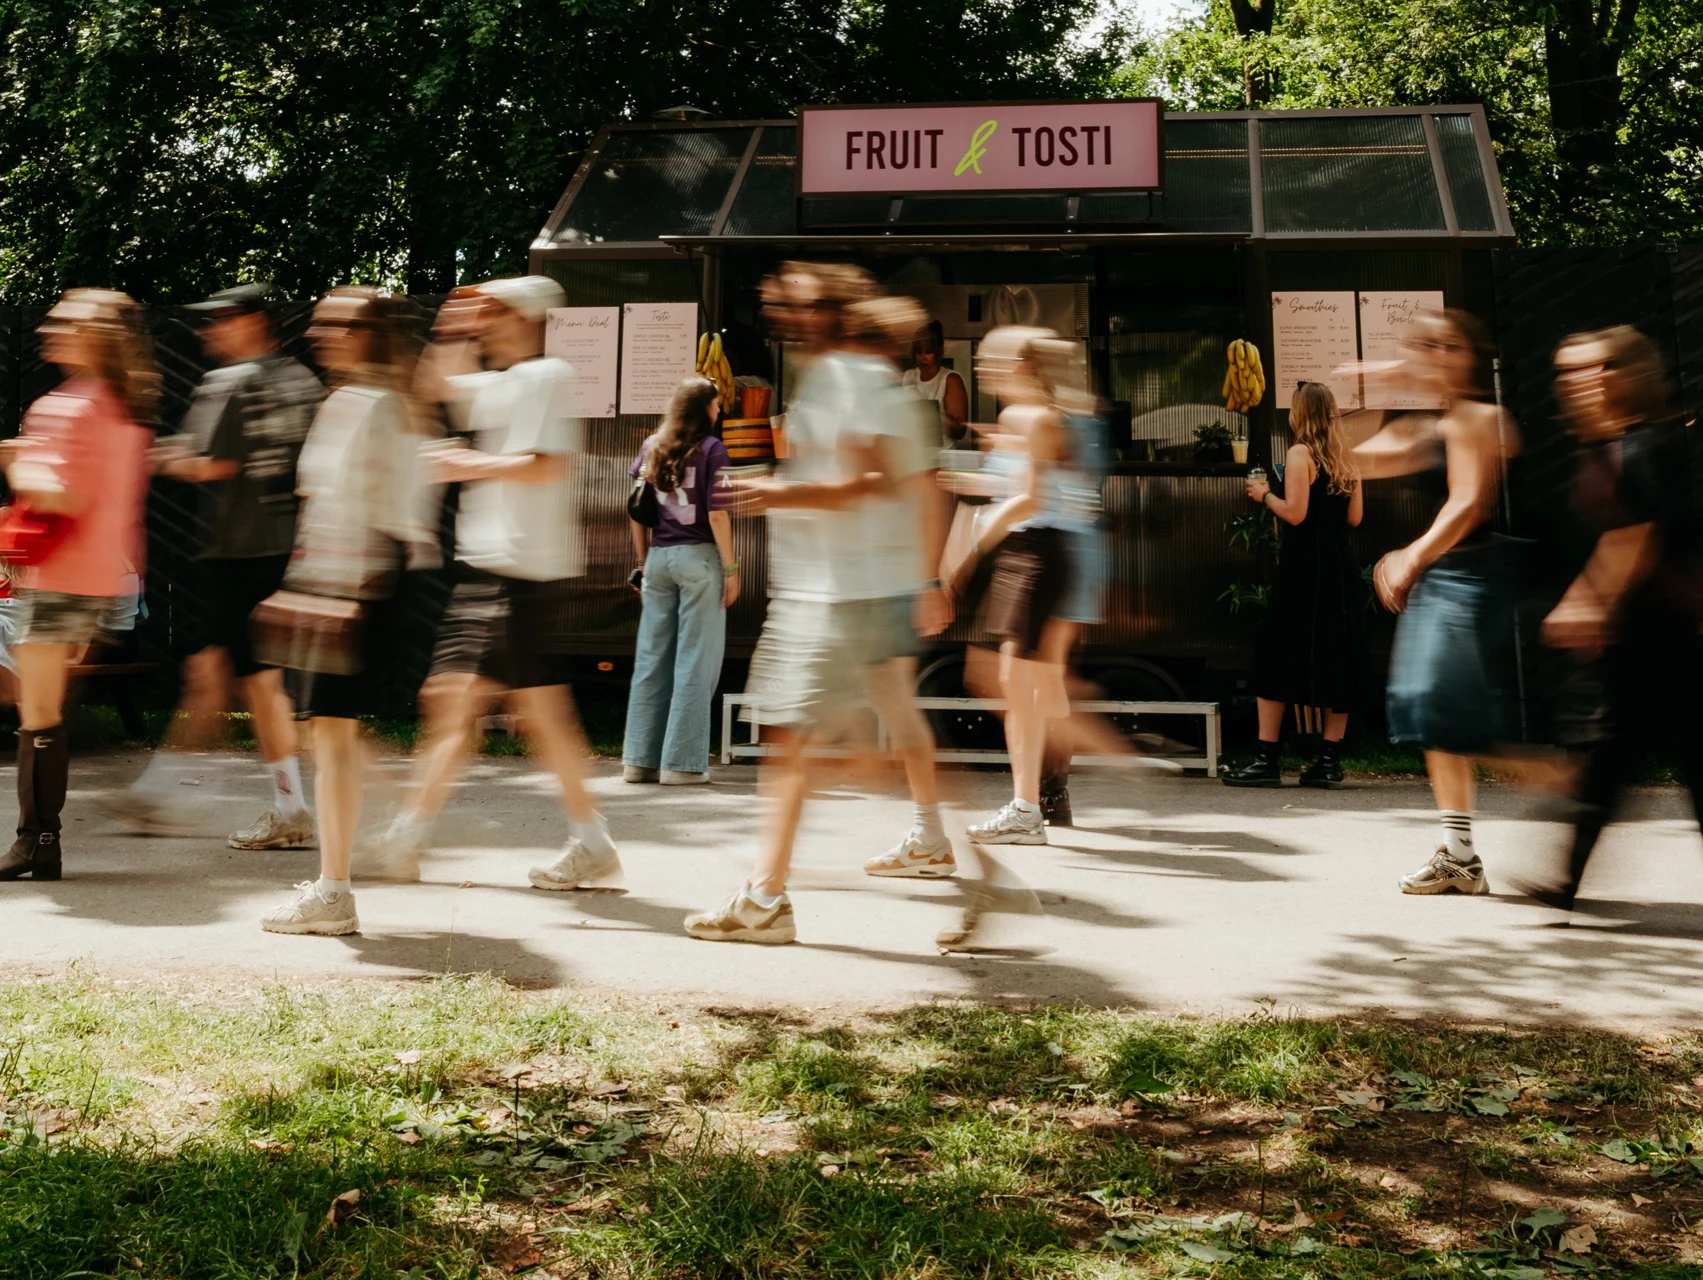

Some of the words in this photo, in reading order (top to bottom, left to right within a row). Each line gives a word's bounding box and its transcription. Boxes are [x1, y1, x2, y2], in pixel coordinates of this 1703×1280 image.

[845, 129, 944, 170] FRUIT
[953, 119, 998, 176] &
[1011, 125, 1112, 167] TOSTI
[1289, 297, 1339, 314] Smoothies
[1380, 298, 1410, 311] Fruit
[555, 317, 584, 330] Menu
[588, 315, 610, 329] Deal
[1387, 311, 1416, 325] Bowls
